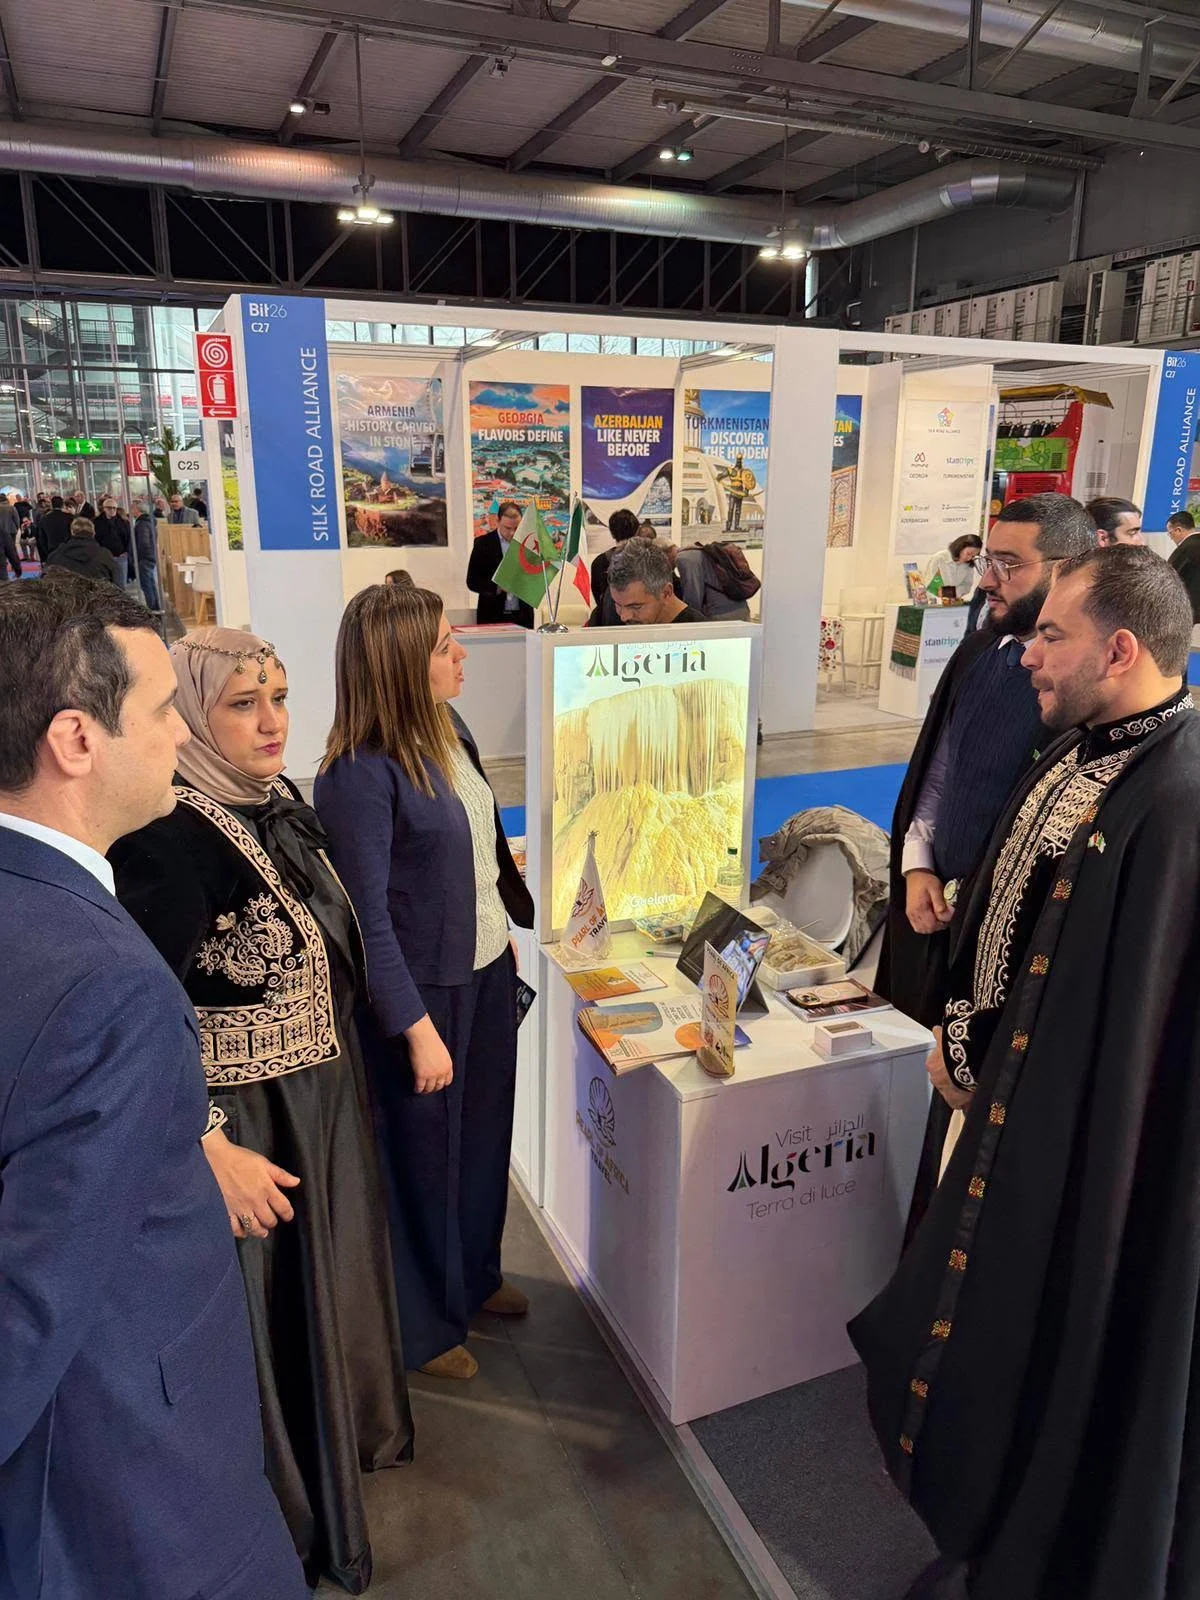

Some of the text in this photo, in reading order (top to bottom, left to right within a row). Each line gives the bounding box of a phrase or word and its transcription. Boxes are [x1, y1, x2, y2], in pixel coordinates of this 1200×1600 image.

[249, 303, 288, 319] Bit26
[251, 322, 270, 333] C27
[367, 405, 416, 418] ARMENIA
[498, 411, 545, 425] GEORGIA
[346, 420, 436, 433] HISTORY CARVED
[594, 414, 663, 429] AZERBAIJAN
[686, 416, 769, 431] TURKMENISTAN
[369, 435, 417, 449] IN STONE
[478, 429, 564, 443] FLAVORS DEFINE
[597, 429, 660, 443] LIKE NEVER
[710, 431, 765, 445] DISCOVER
[300, 347, 329, 541] SILK ROAD ALLIANCE
[607, 443, 650, 457] BEFORE
[1170, 387, 1197, 515] LK ROAD ALLIANCE
[704, 446, 769, 460] THE HIDDEN
[177, 460, 200, 472] C25
[586, 643, 706, 688] Algeria
[631, 892, 676, 907] Guelma
[775, 1125, 813, 1148] Visit
[726, 1131, 876, 1193] Algeria
[746, 1179, 857, 1221] Terra di luce
